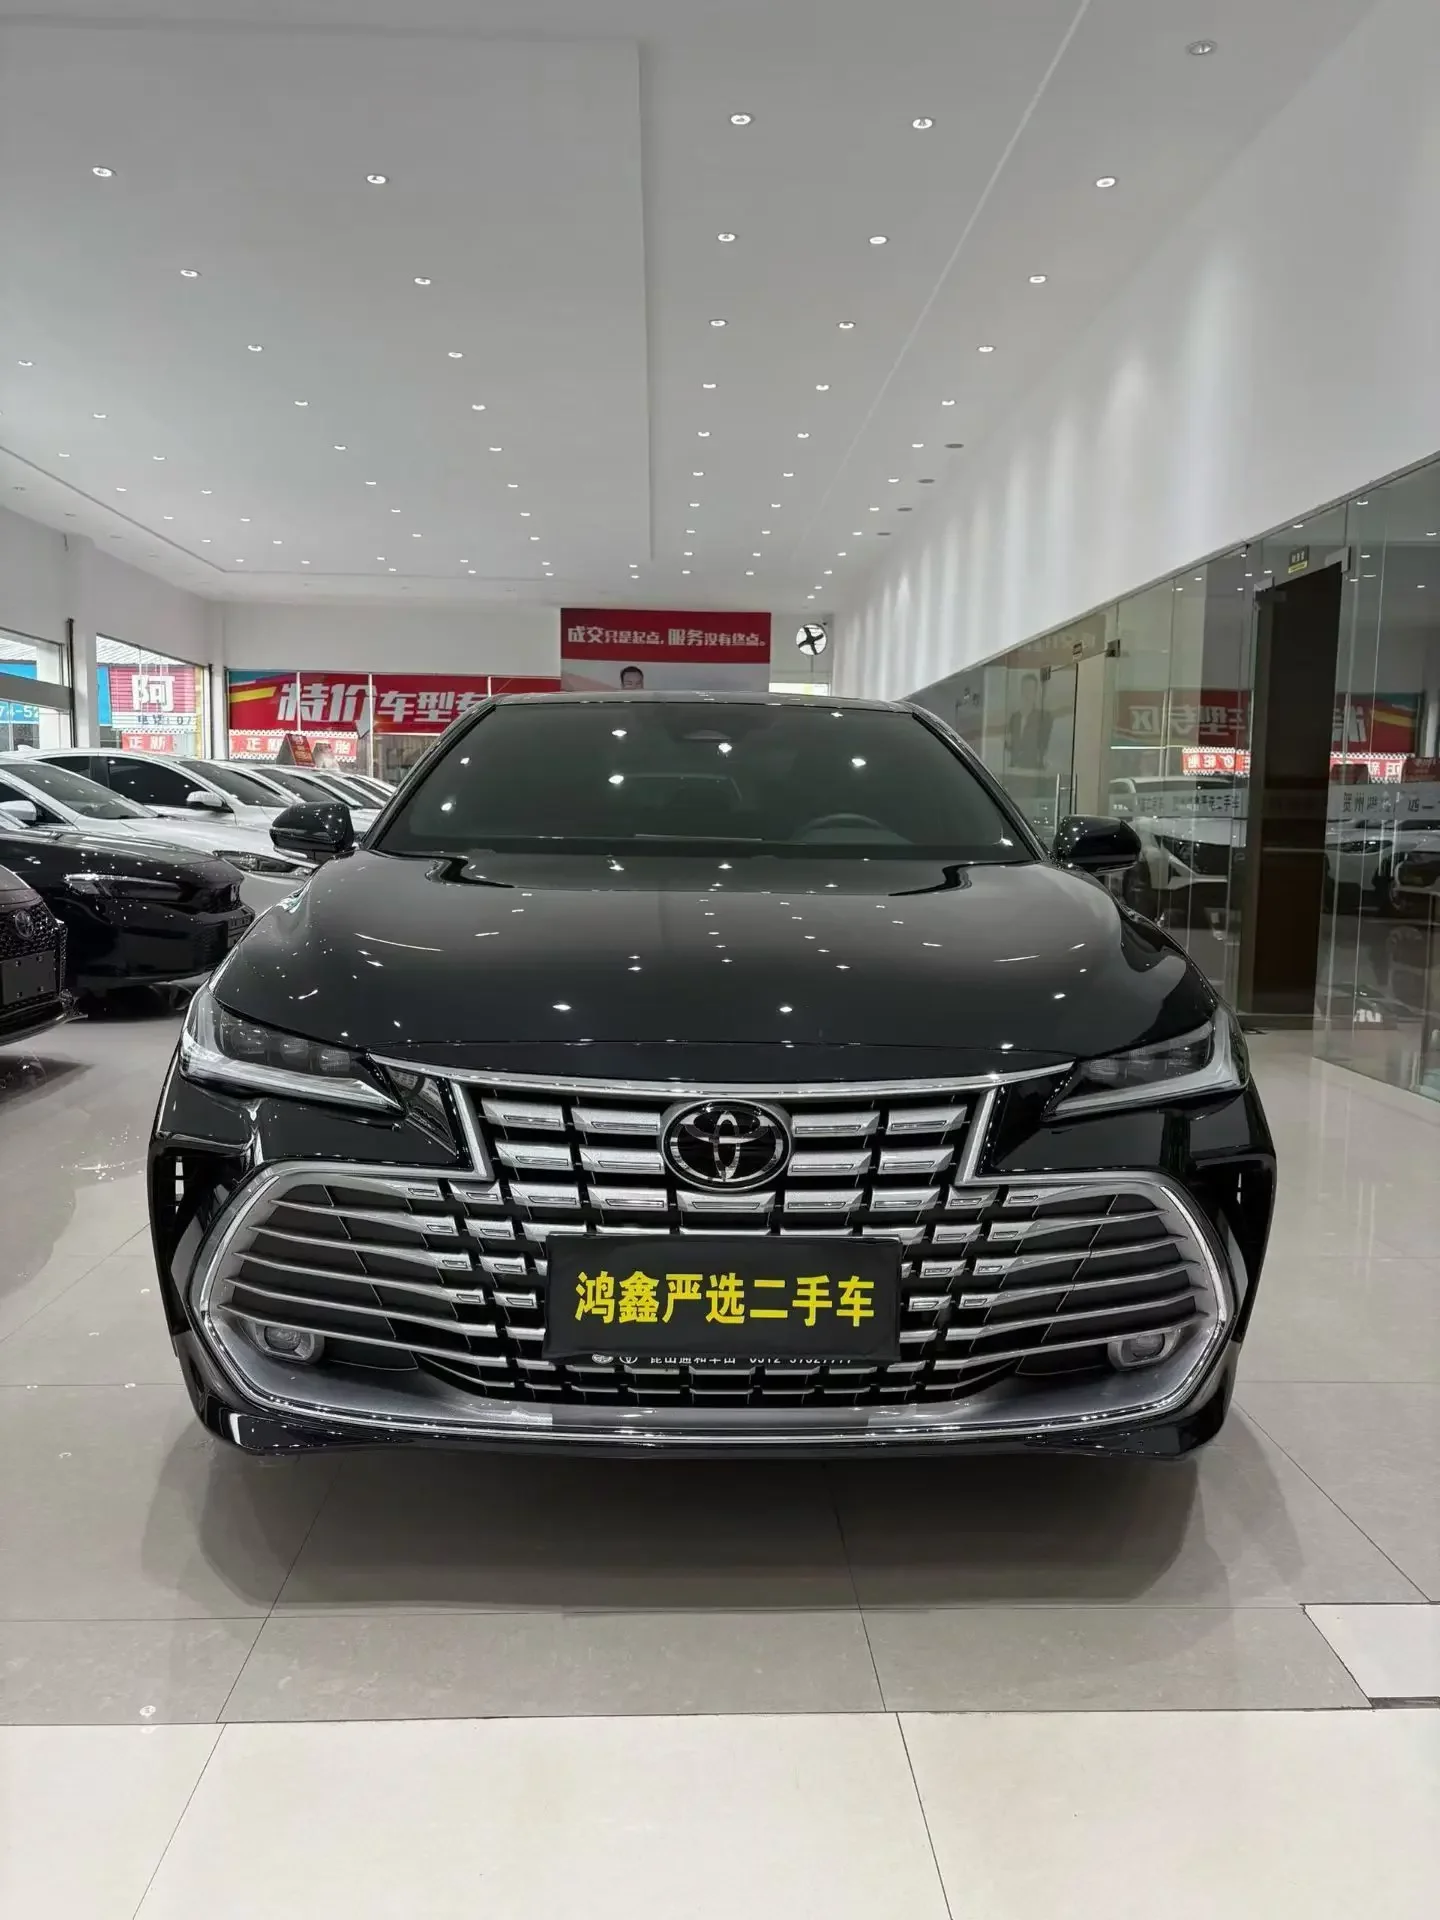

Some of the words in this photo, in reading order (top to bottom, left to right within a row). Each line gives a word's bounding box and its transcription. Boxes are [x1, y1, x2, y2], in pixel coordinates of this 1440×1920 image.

[132, 674, 175, 712] 阿
[574, 1270, 875, 1328] 鸿鑫严选二手车
